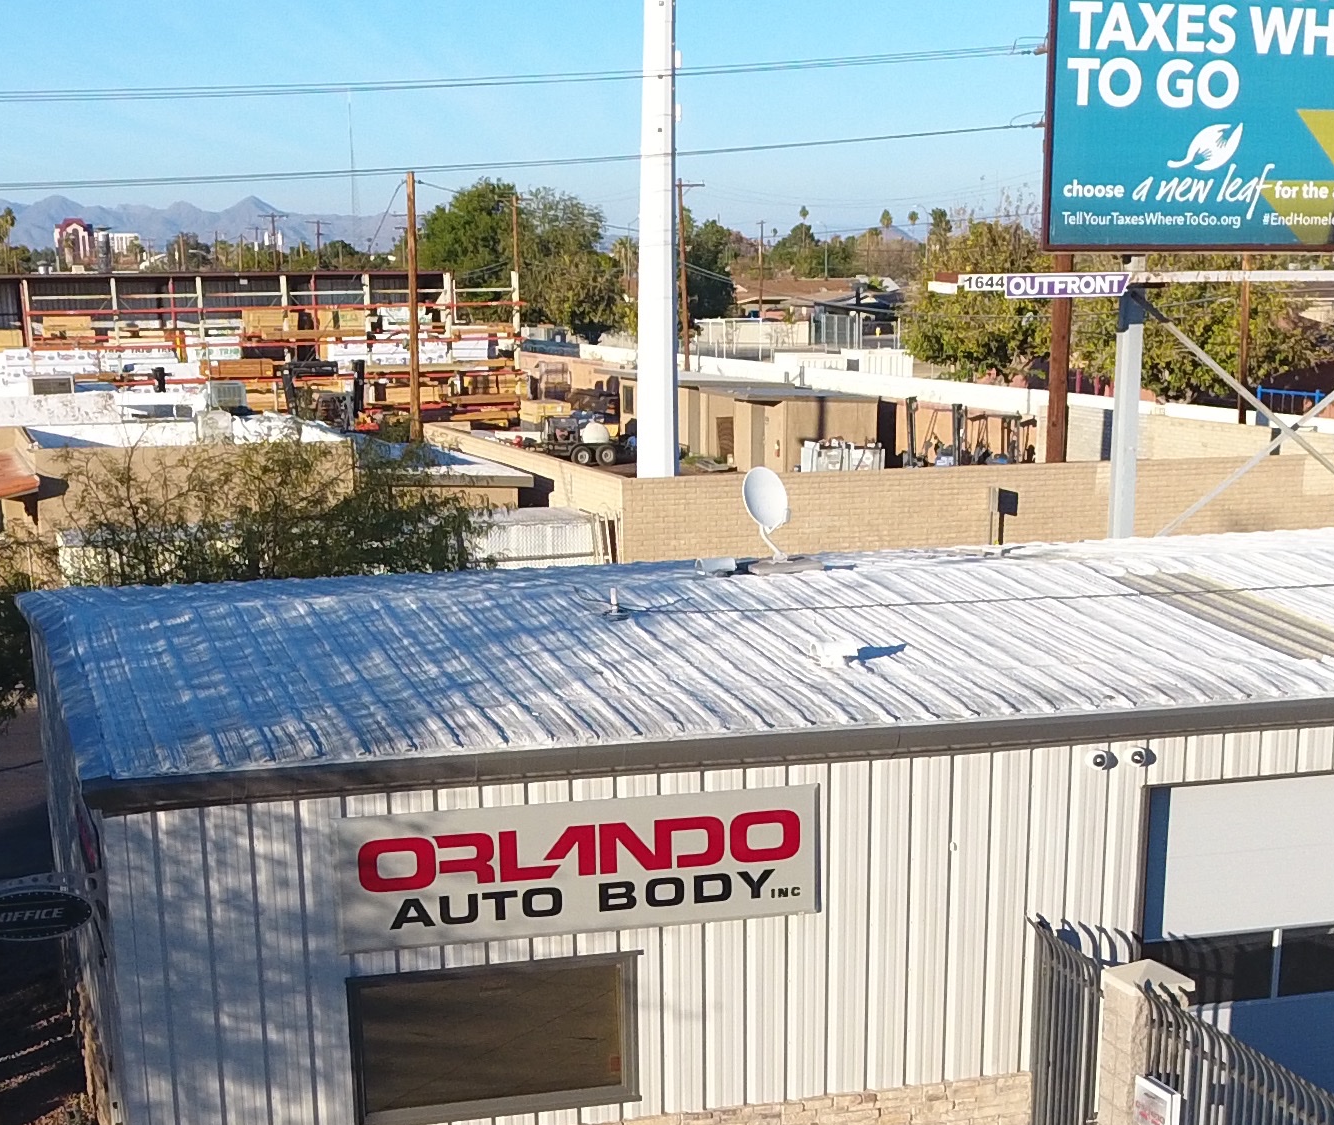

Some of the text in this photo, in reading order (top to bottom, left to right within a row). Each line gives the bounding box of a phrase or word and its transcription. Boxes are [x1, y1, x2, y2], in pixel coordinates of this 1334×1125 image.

[1069, 1, 1238, 55] TAXES
[1067, 57, 1240, 109] TO GO
[1063, 179, 1125, 198] choose
[1132, 175, 1154, 202] a
[1155, 176, 1214, 204] new
[1216, 163, 1275, 220] leaf
[1274, 180, 1299, 199] for
[1302, 181, 1328, 199] the
[1062, 211, 1242, 229] TellYourTaxesWhereToGo.org
[964, 275, 1125, 295] 1644 OUTFRONT
[357, 809, 801, 893] ORLANDO
[389, 868, 801, 931] AUTO BODY INC
